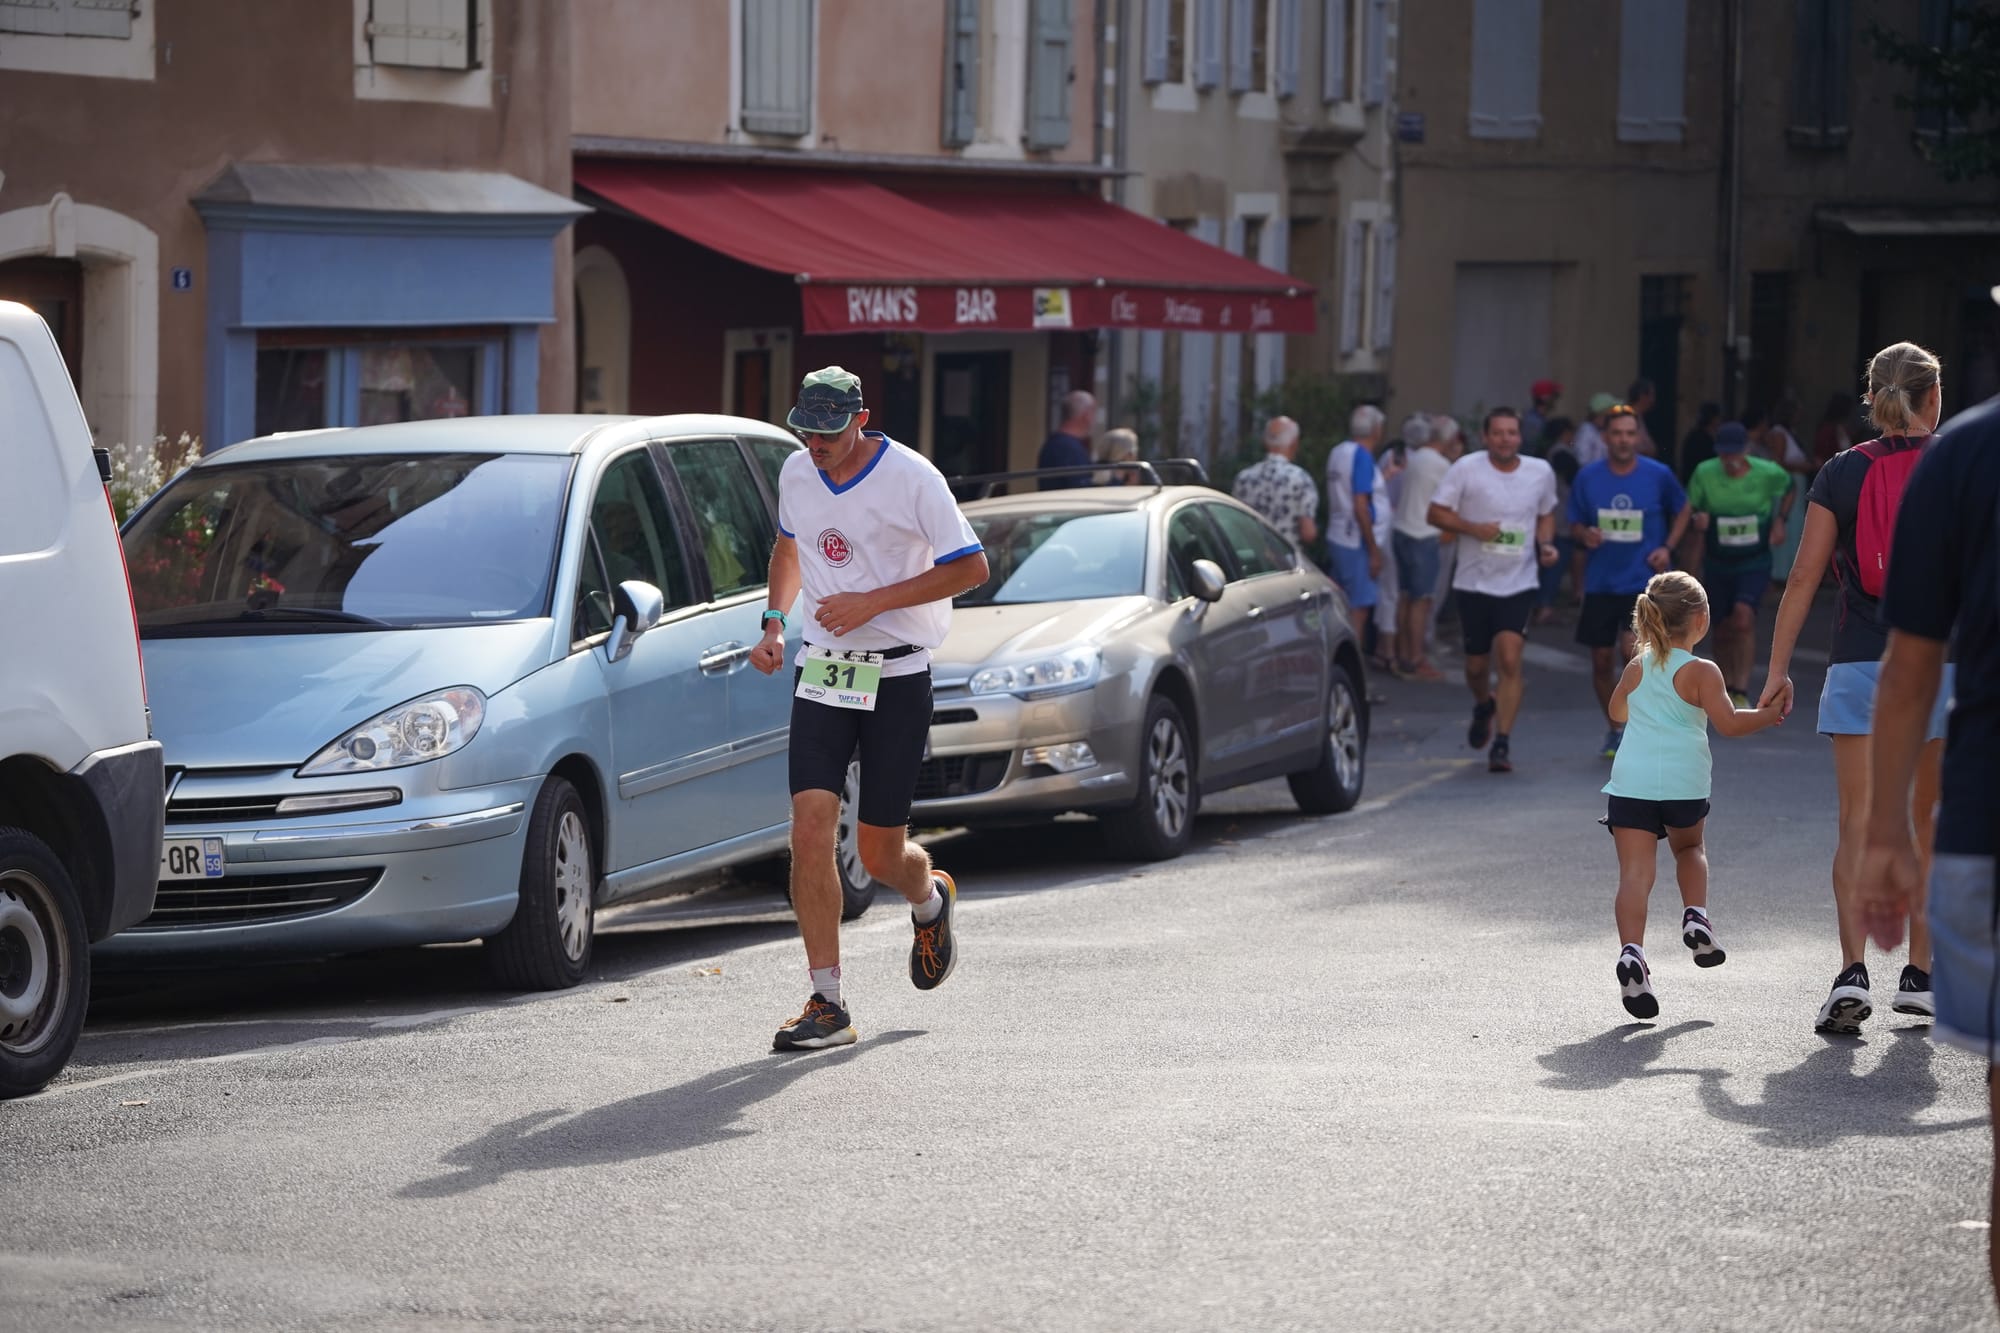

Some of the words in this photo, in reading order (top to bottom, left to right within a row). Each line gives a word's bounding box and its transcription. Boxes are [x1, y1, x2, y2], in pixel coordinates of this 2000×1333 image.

[847, 287, 918, 323] RYAN'S
[955, 288, 998, 324] BAR
[1608, 518, 1631, 531] 17
[822, 664, 857, 689] 31
[206, 857, 221, 872] 59
